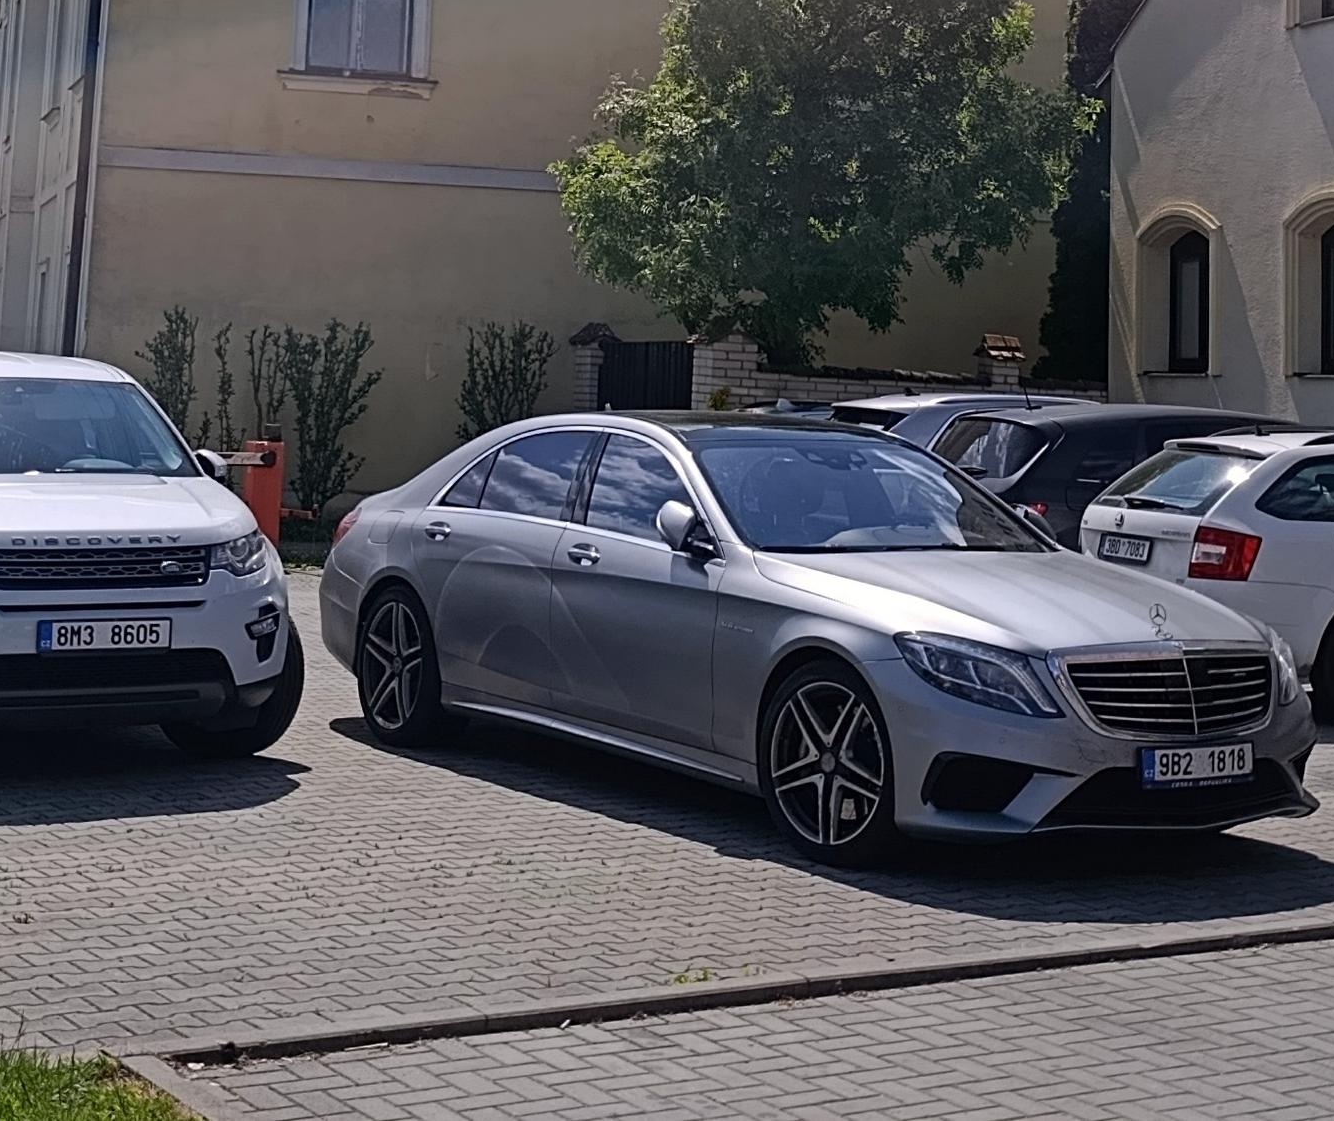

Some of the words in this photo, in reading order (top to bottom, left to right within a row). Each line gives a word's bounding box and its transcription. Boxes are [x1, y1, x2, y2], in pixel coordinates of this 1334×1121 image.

[11, 534, 181, 546] DISCOVERY
[1124, 540, 1146, 558] 7083
[40, 640, 51, 648] CZ
[56, 625, 95, 647] 8M3
[110, 623, 161, 645] 8605
[1159, 752, 1193, 777] 9B2
[1208, 747, 1246, 773] 1818
